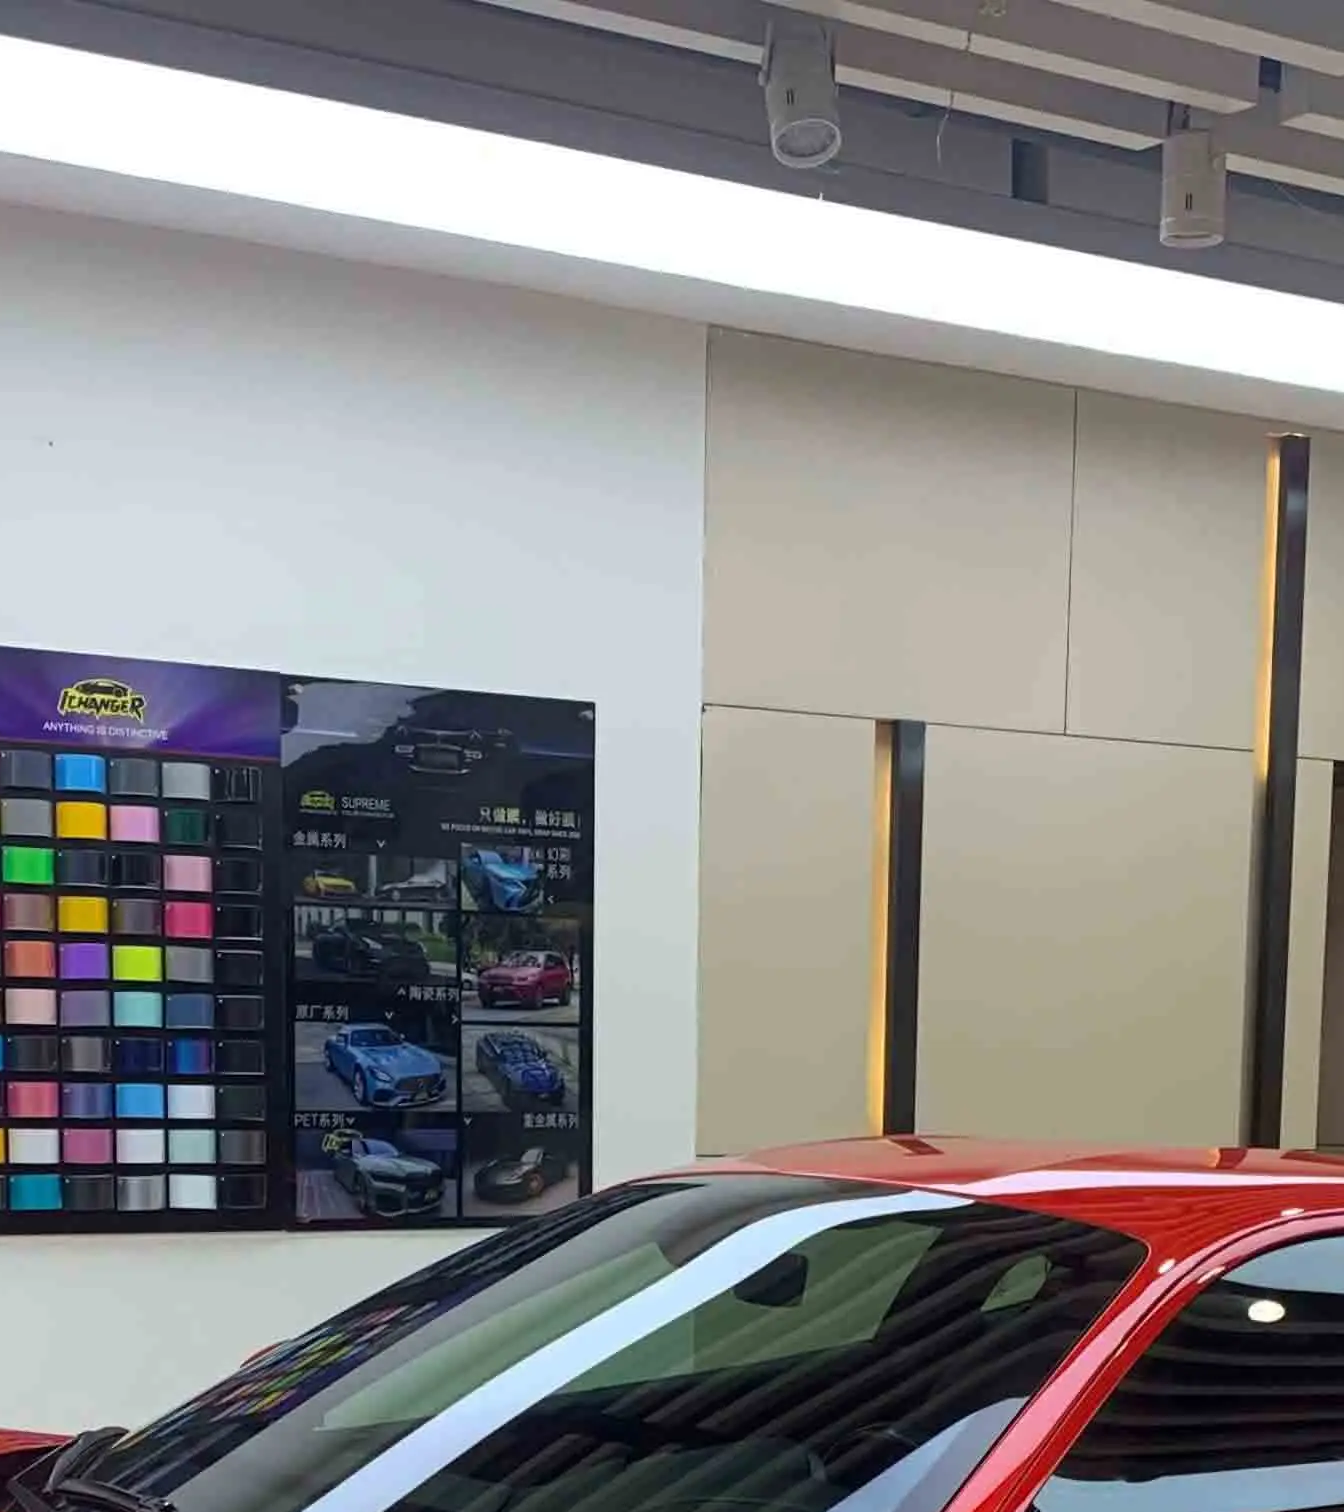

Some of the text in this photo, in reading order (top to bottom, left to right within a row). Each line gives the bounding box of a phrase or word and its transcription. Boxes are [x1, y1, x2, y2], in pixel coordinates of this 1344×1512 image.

[42, 721, 169, 741] ANYTHING IS DISTINCTIVE
[294, 1112, 345, 1129] PET系列
